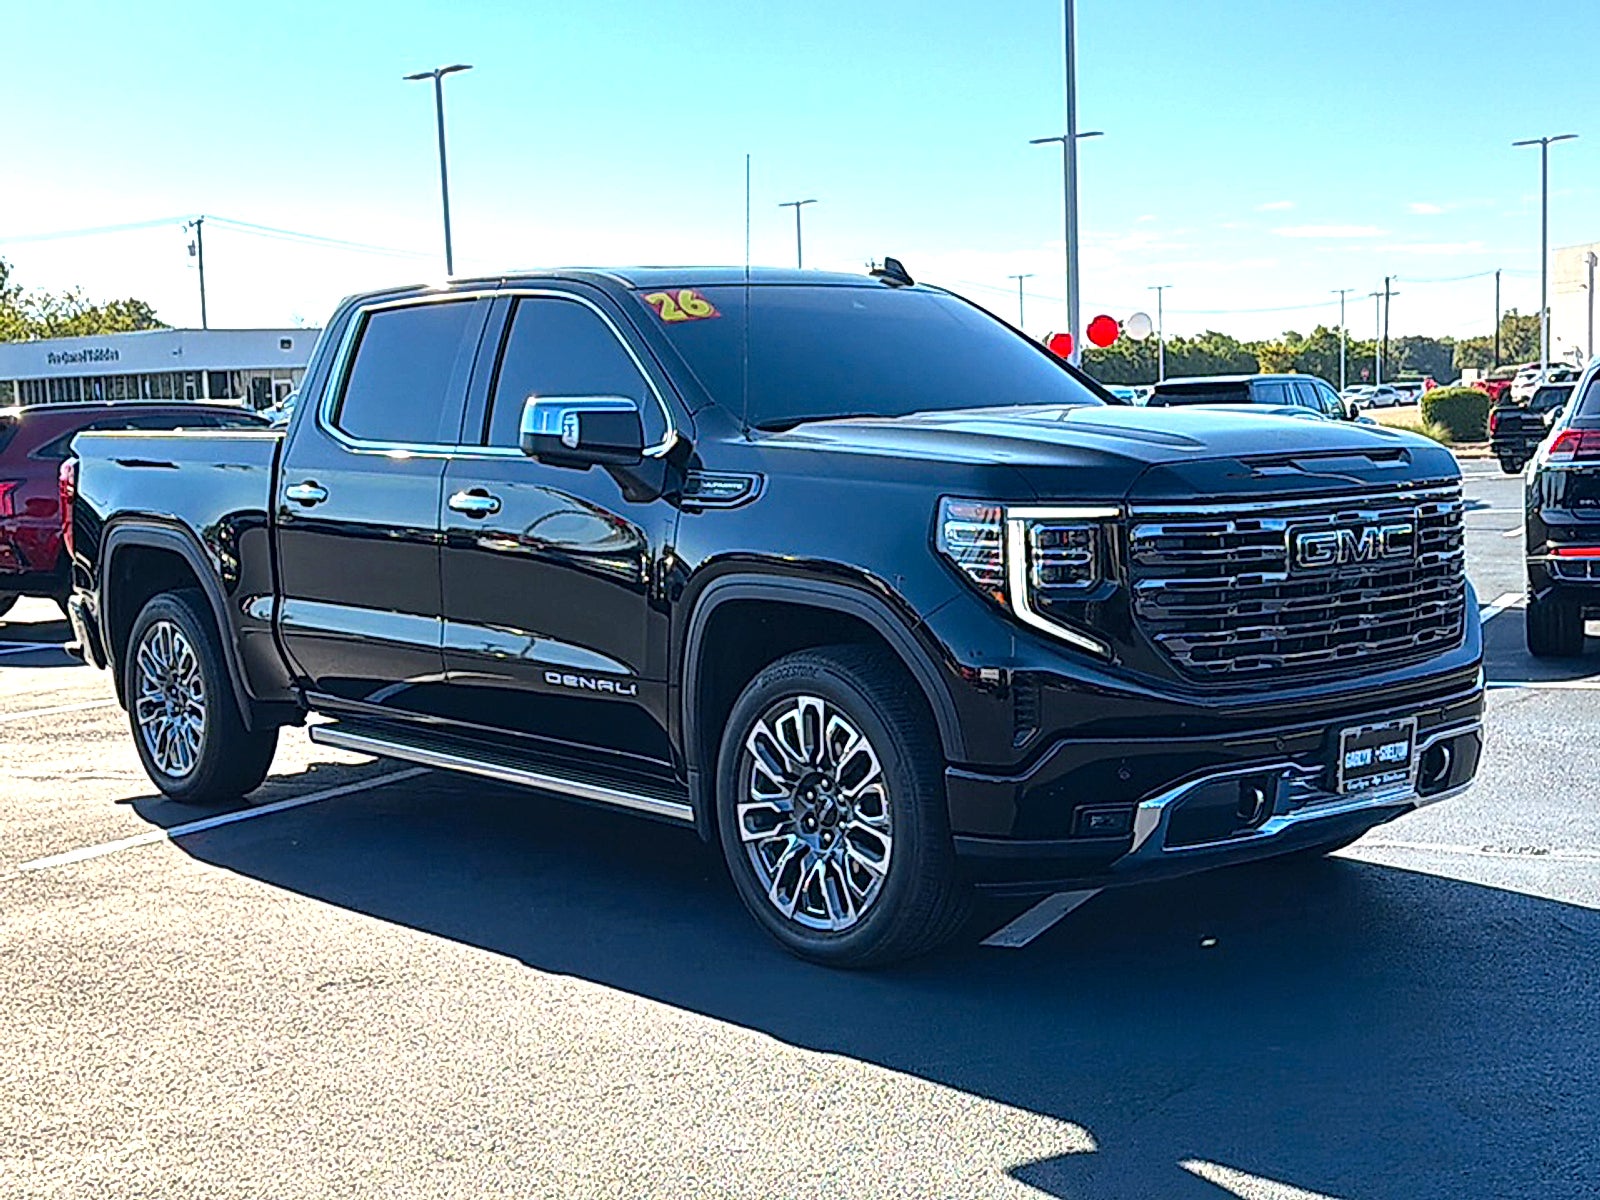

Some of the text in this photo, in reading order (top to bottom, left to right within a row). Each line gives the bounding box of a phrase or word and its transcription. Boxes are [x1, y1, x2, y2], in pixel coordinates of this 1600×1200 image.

[643, 288, 715, 322] 26
[1296, 523, 1413, 568] GMC
[544, 671, 637, 697] DENALI
